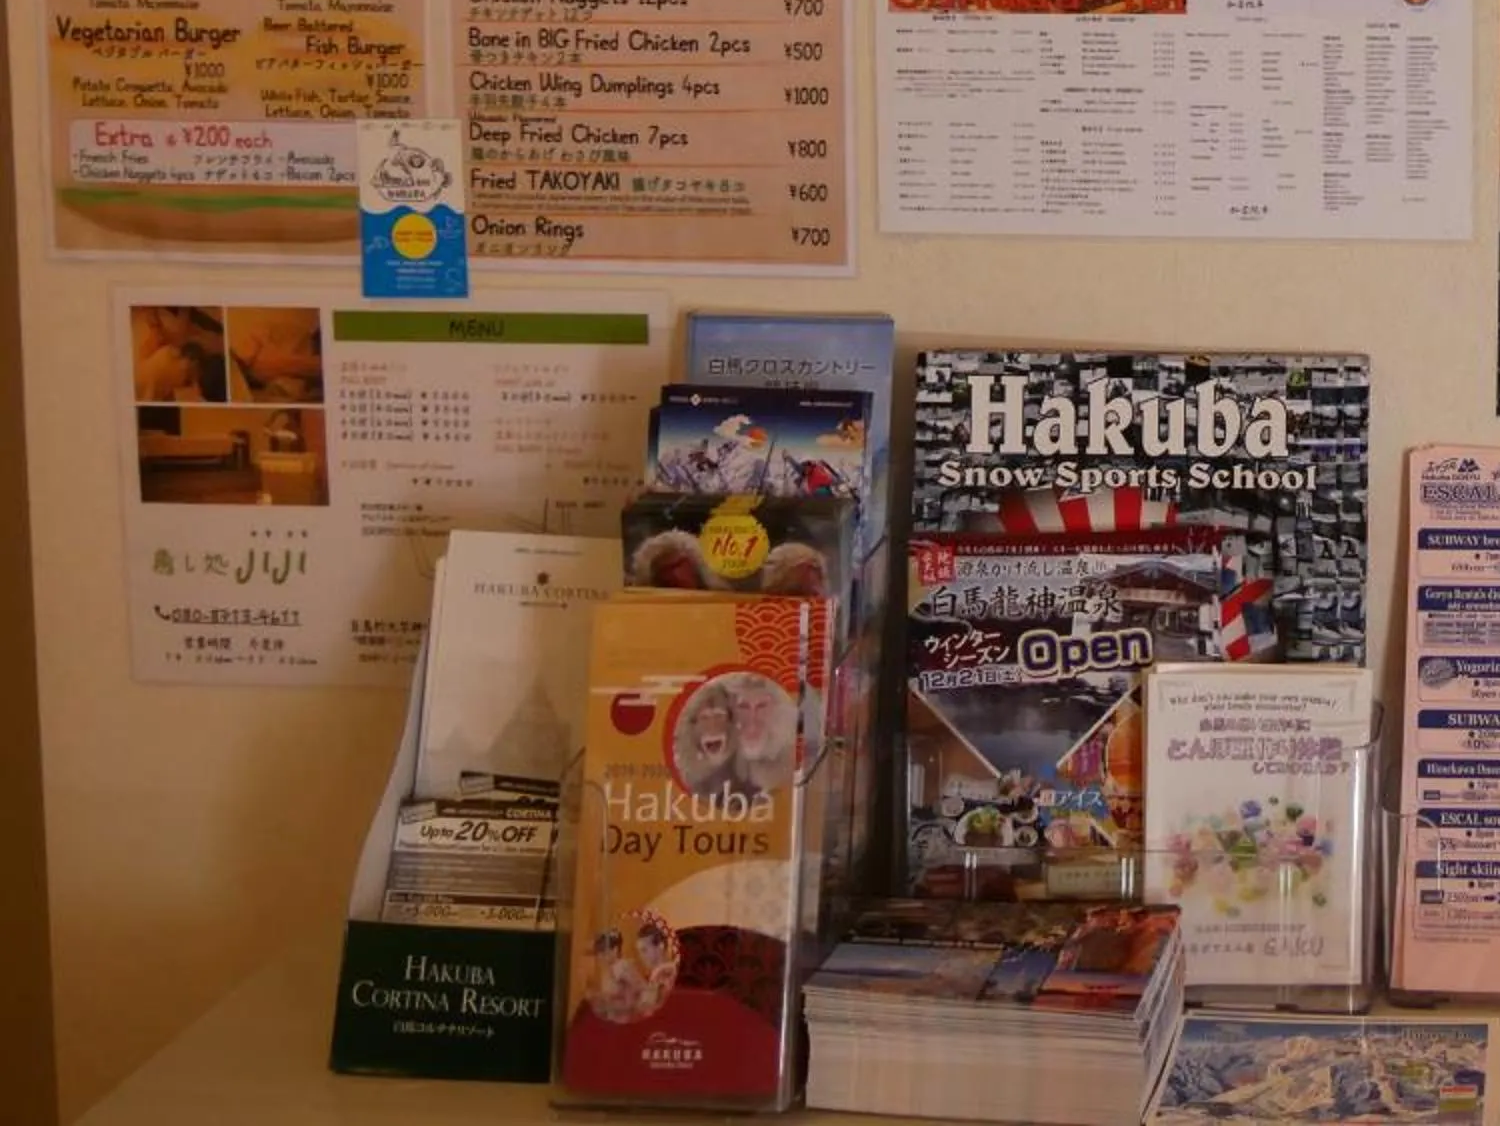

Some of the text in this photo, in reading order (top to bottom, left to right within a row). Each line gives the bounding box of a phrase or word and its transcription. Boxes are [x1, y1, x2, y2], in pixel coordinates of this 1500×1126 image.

[56, 16, 241, 49] Vegetarian Burger
[468, 28, 751, 55] Bone in BIG Fried Chicken 2pcs
[306, 37, 406, 60] Fish Burger
[469, 72, 829, 105] Chicken Wing Dumplings 4pcs ¥1000
[95, 122, 273, 148] Extra ¥200 each
[469, 121, 827, 158] Deep Fried Chicken 7pcs ¥800
[470, 169, 828, 202] Fried TAKOYAKI ¥600
[471, 215, 831, 246] Onion Rings ¥700
[449, 320, 506, 338] MENU
[708, 359, 876, 375] 白馬クロスカントリー
[965, 373, 1289, 458] Hakuba
[938, 463, 1317, 494] Snow Sports School
[1427, 534, 1481, 546] SUBWAY
[930, 585, 1123, 620] 白馬龍神温泉
[1019, 628, 1152, 678] Open
[604, 781, 774, 823] Hakuba
[1440, 812, 1482, 825] ESCAL
[502, 827, 538, 843] OFF
[673, 825, 769, 855] Tours
[405, 954, 495, 986] HAKUBA
[352, 980, 545, 1018] CORTINA RESORT
